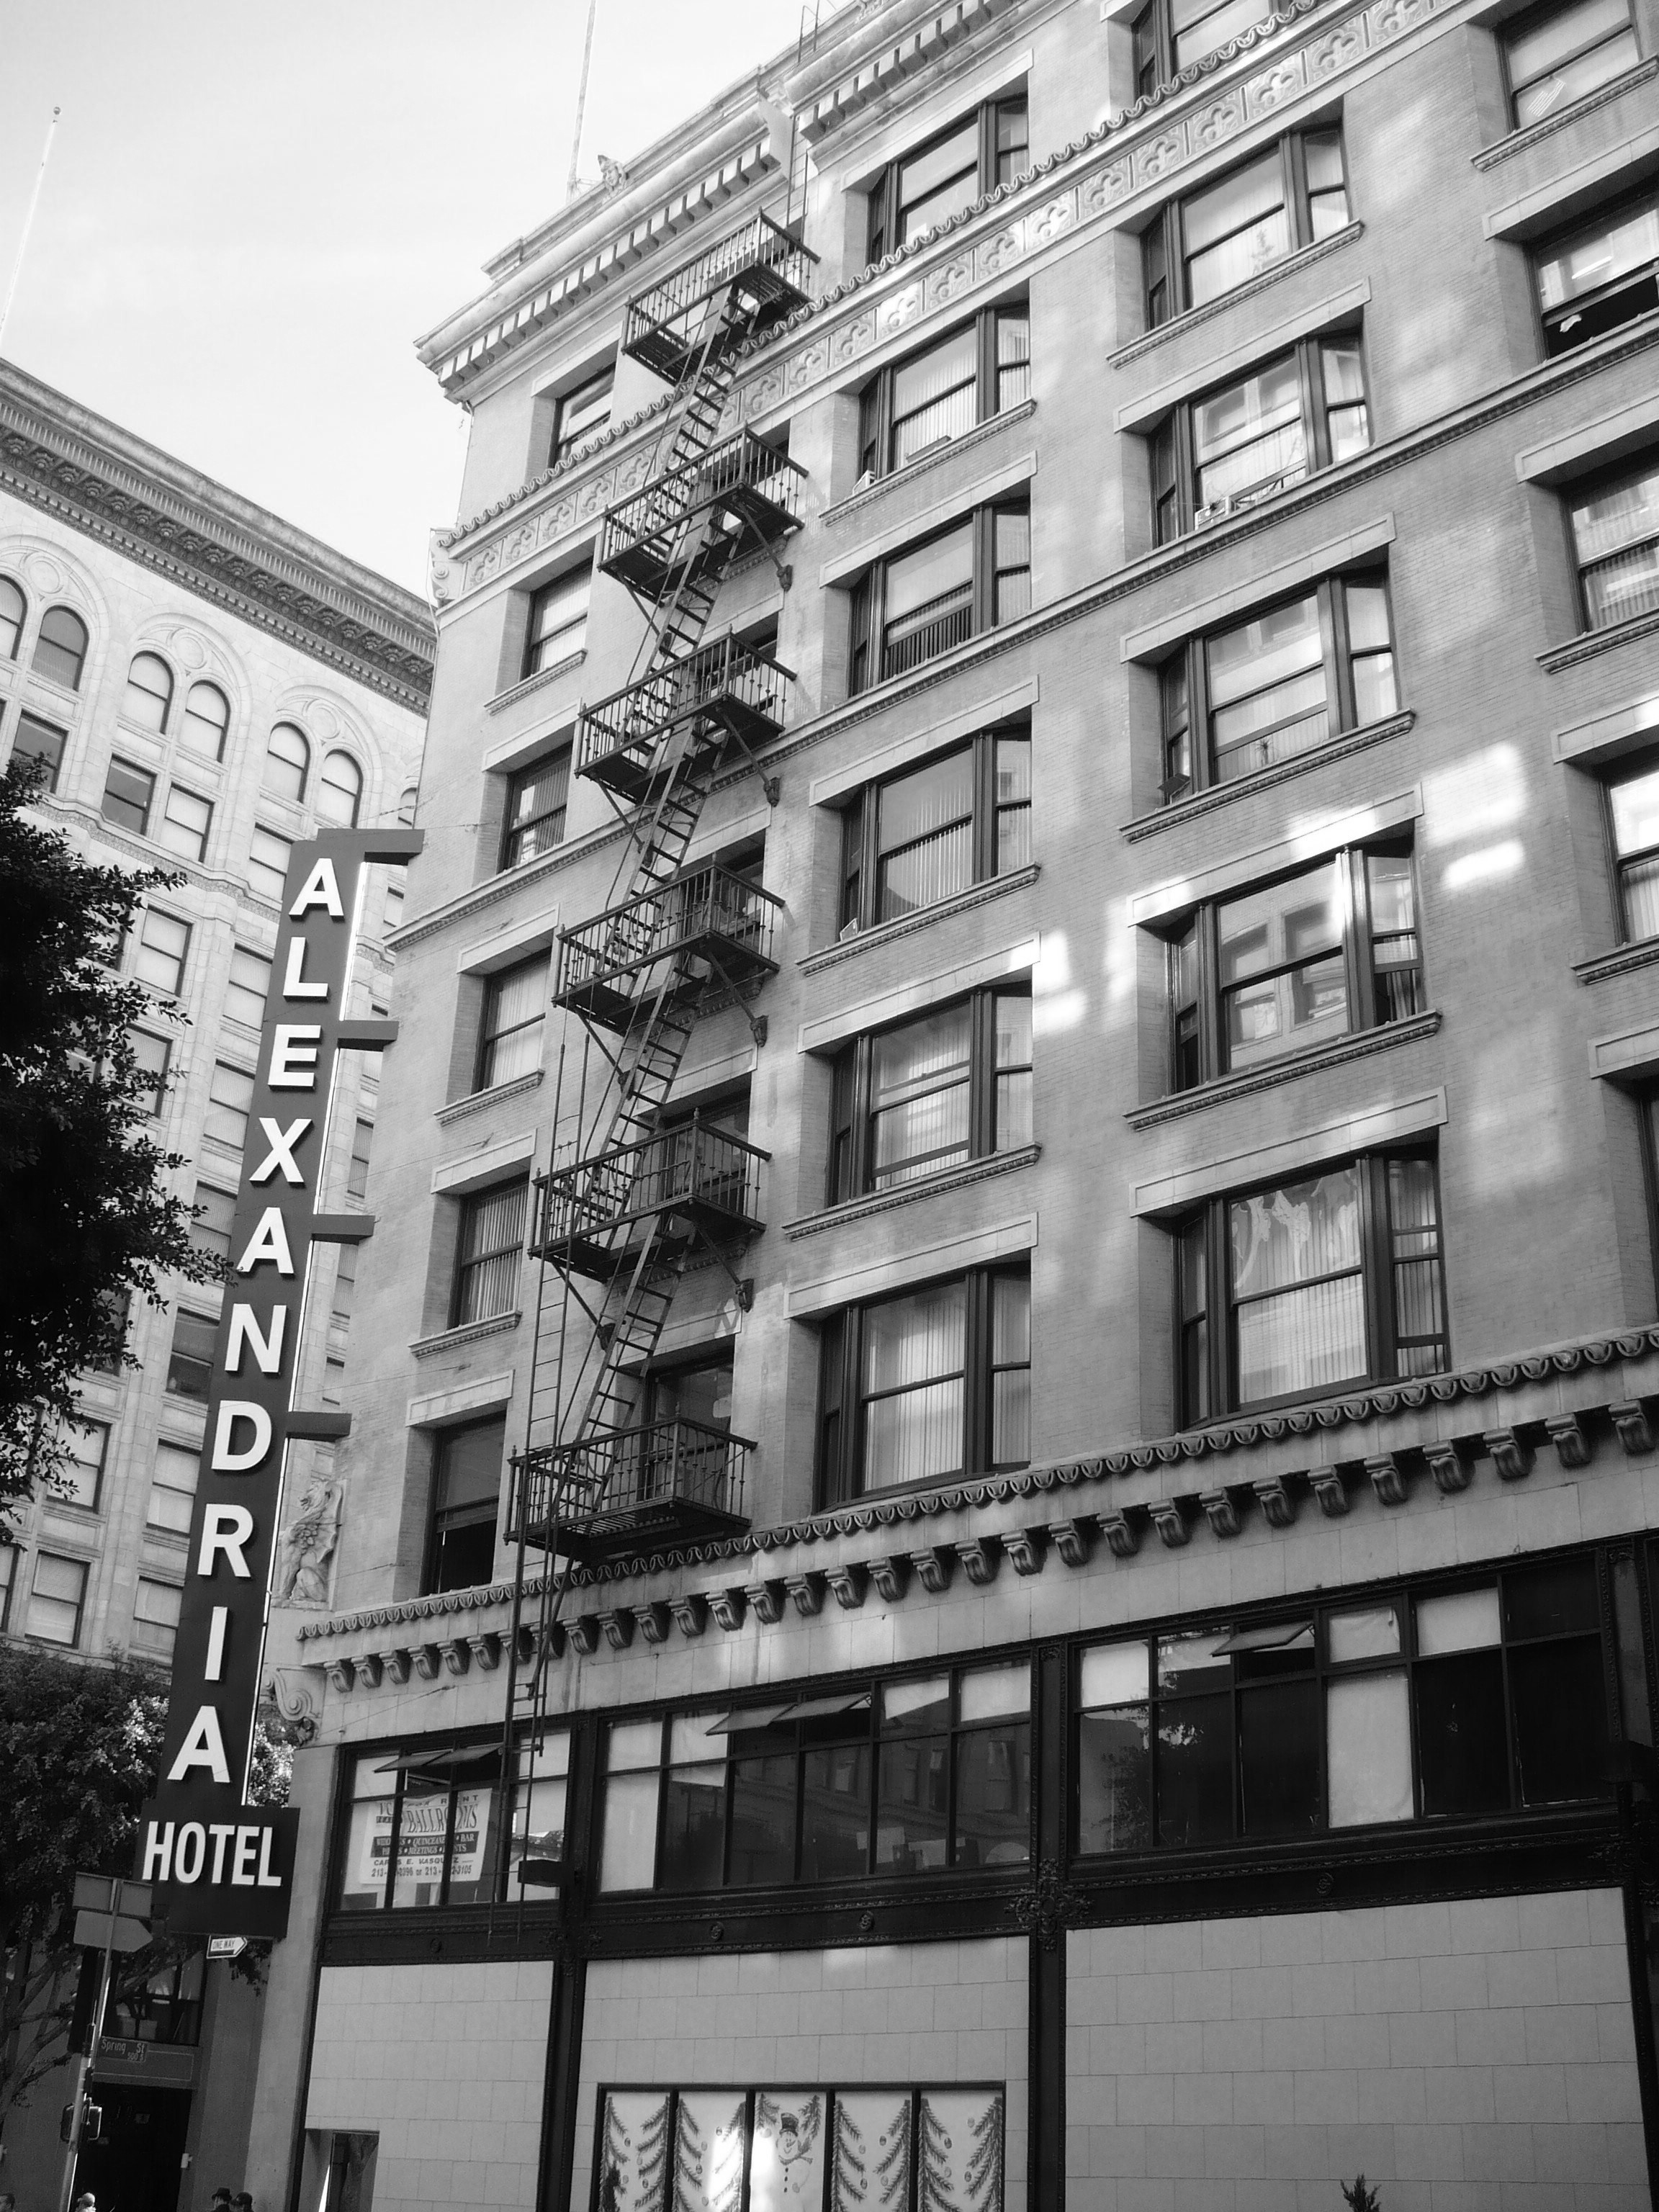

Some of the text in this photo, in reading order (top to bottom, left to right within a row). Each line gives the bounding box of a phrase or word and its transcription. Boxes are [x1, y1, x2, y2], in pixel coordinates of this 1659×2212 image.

[167, 858, 344, 1784] ALEXANDRIA
[441, 1795, 478, 1804] RNT
[460, 1833, 475, 1842] BAR
[143, 1821, 282, 1887] HOTEL
[418, 1856, 459, 1865] VASQUZ
[102, 2039, 145, 2054] Spring St
